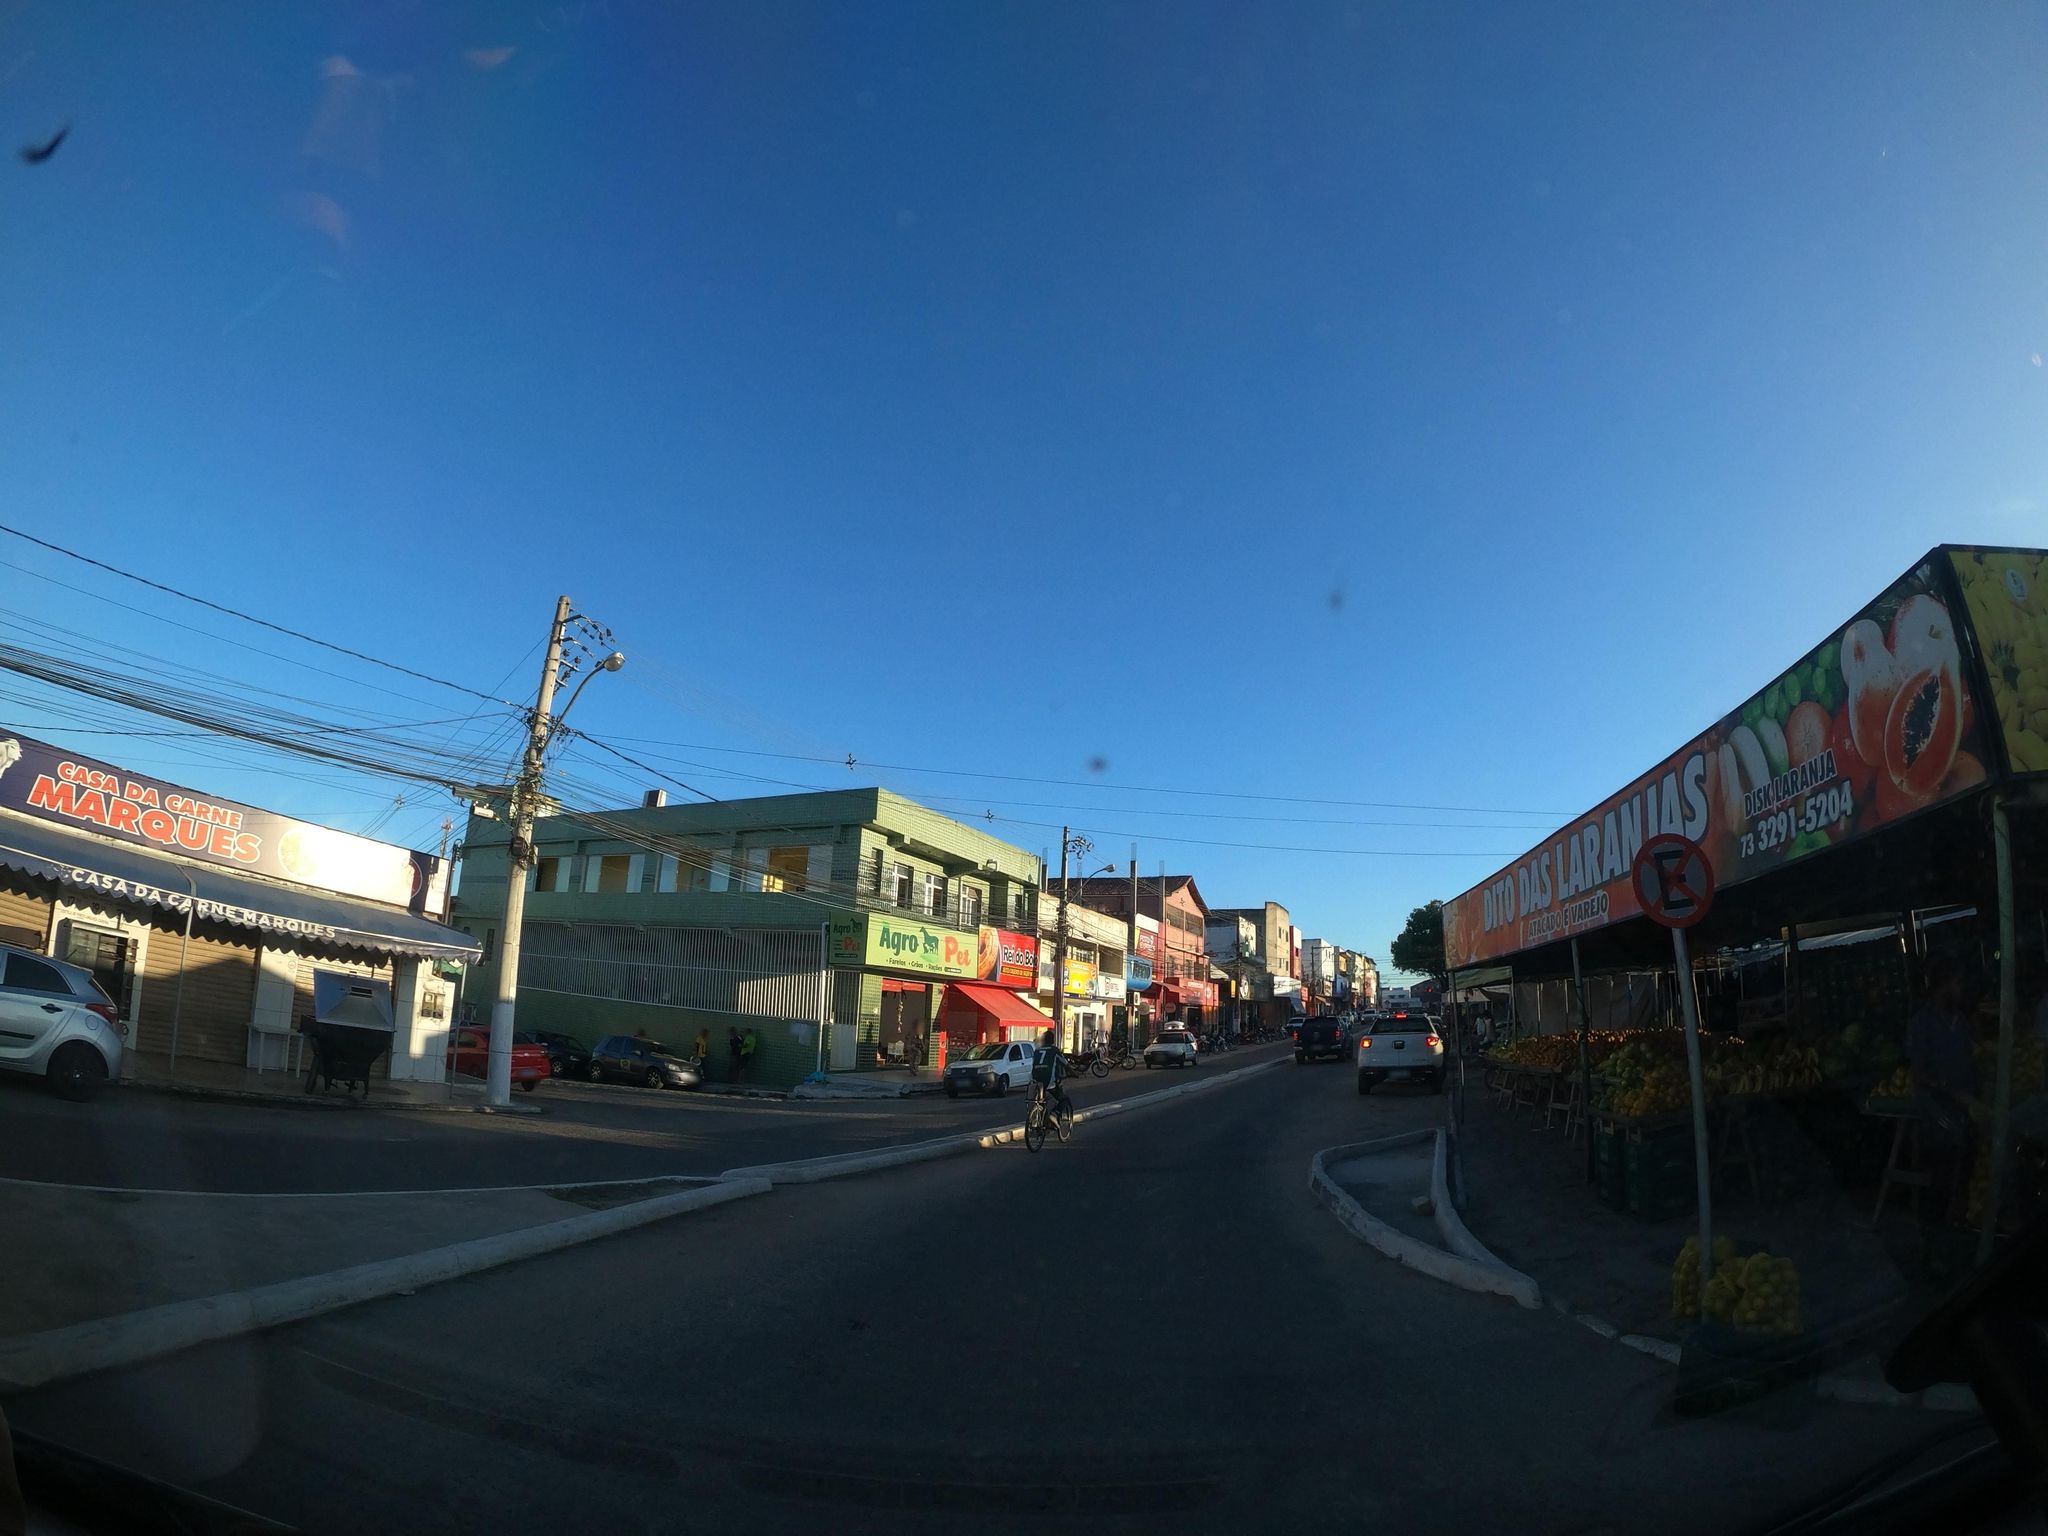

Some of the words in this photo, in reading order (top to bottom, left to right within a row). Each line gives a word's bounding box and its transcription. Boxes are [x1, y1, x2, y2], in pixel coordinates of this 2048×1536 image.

[58, 761, 120, 796] CASA
[124, 781, 160, 808] DA
[165, 794, 243, 830] CARNE
[1744, 783, 1772, 819] DISK
[1774, 748, 1838, 805] LARANJA
[27, 774, 263, 864] MARQUES
[1740, 832, 1754, 859] 73
[1757, 780, 1854, 852] 3291-5204
[71, 869, 128, 895] CASA
[135, 884, 162, 903] DA
[167, 894, 237, 920] CARNE
[243, 909, 336, 938] MARQUES
[1483, 874, 1515, 932] DITO
[1518, 848, 1552, 916] DAS
[1528, 910, 1562, 938] ATACADO
[1569, 890, 1609, 925] VAREJO
[879, 924, 919, 957] Agro
[944, 935, 971, 967] Pet
[1003, 945, 1015, 963] Rei
[1015, 948, 1024, 965] do
[1039, 1050, 1047, 1064] 7
